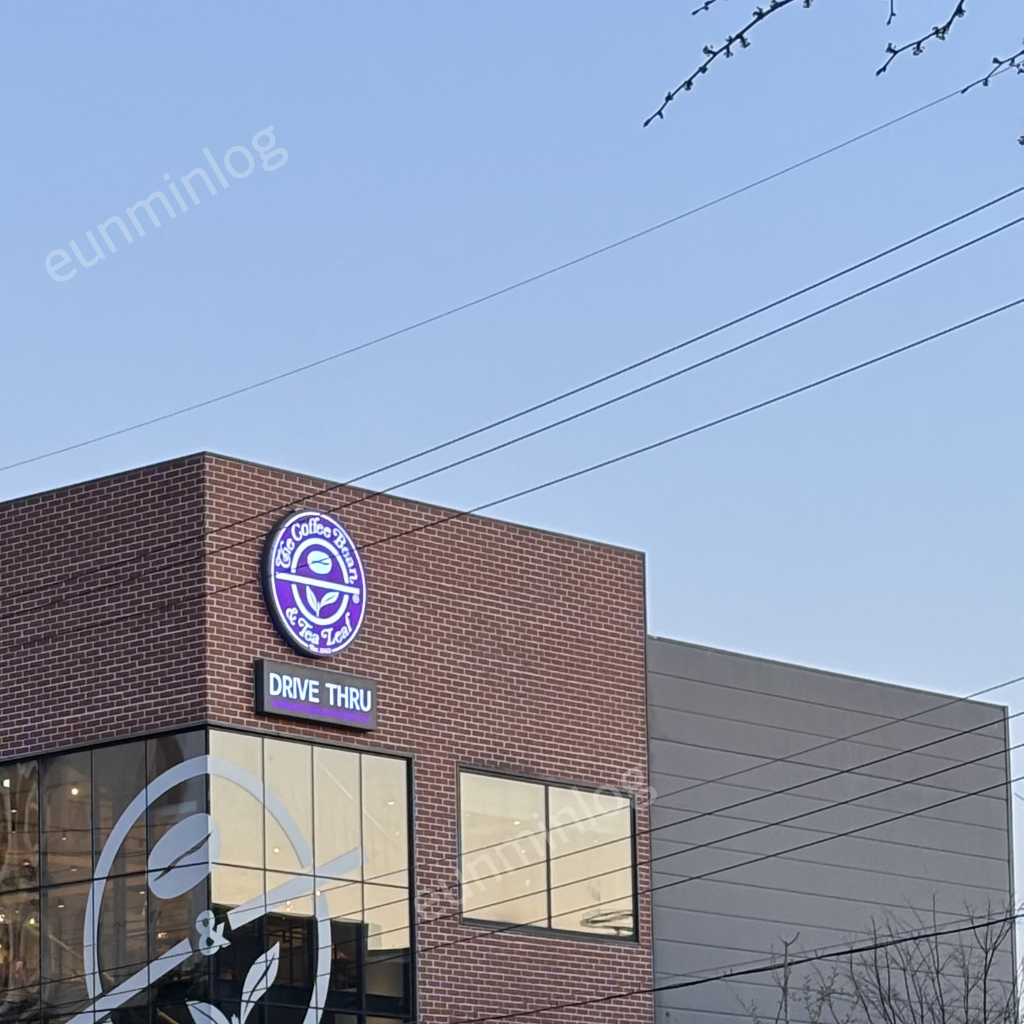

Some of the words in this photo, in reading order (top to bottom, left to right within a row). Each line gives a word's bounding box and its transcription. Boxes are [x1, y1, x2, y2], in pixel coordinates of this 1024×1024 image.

[276, 538, 295, 569] The
[291, 517, 332, 541] Coffee
[333, 528, 359, 584] Bean
[298, 620, 319, 645] Tea
[322, 612, 353, 646] Leaf
[269, 673, 320, 703] DRIVE
[325, 682, 372, 712] THRU
[195, 909, 232, 957] &
